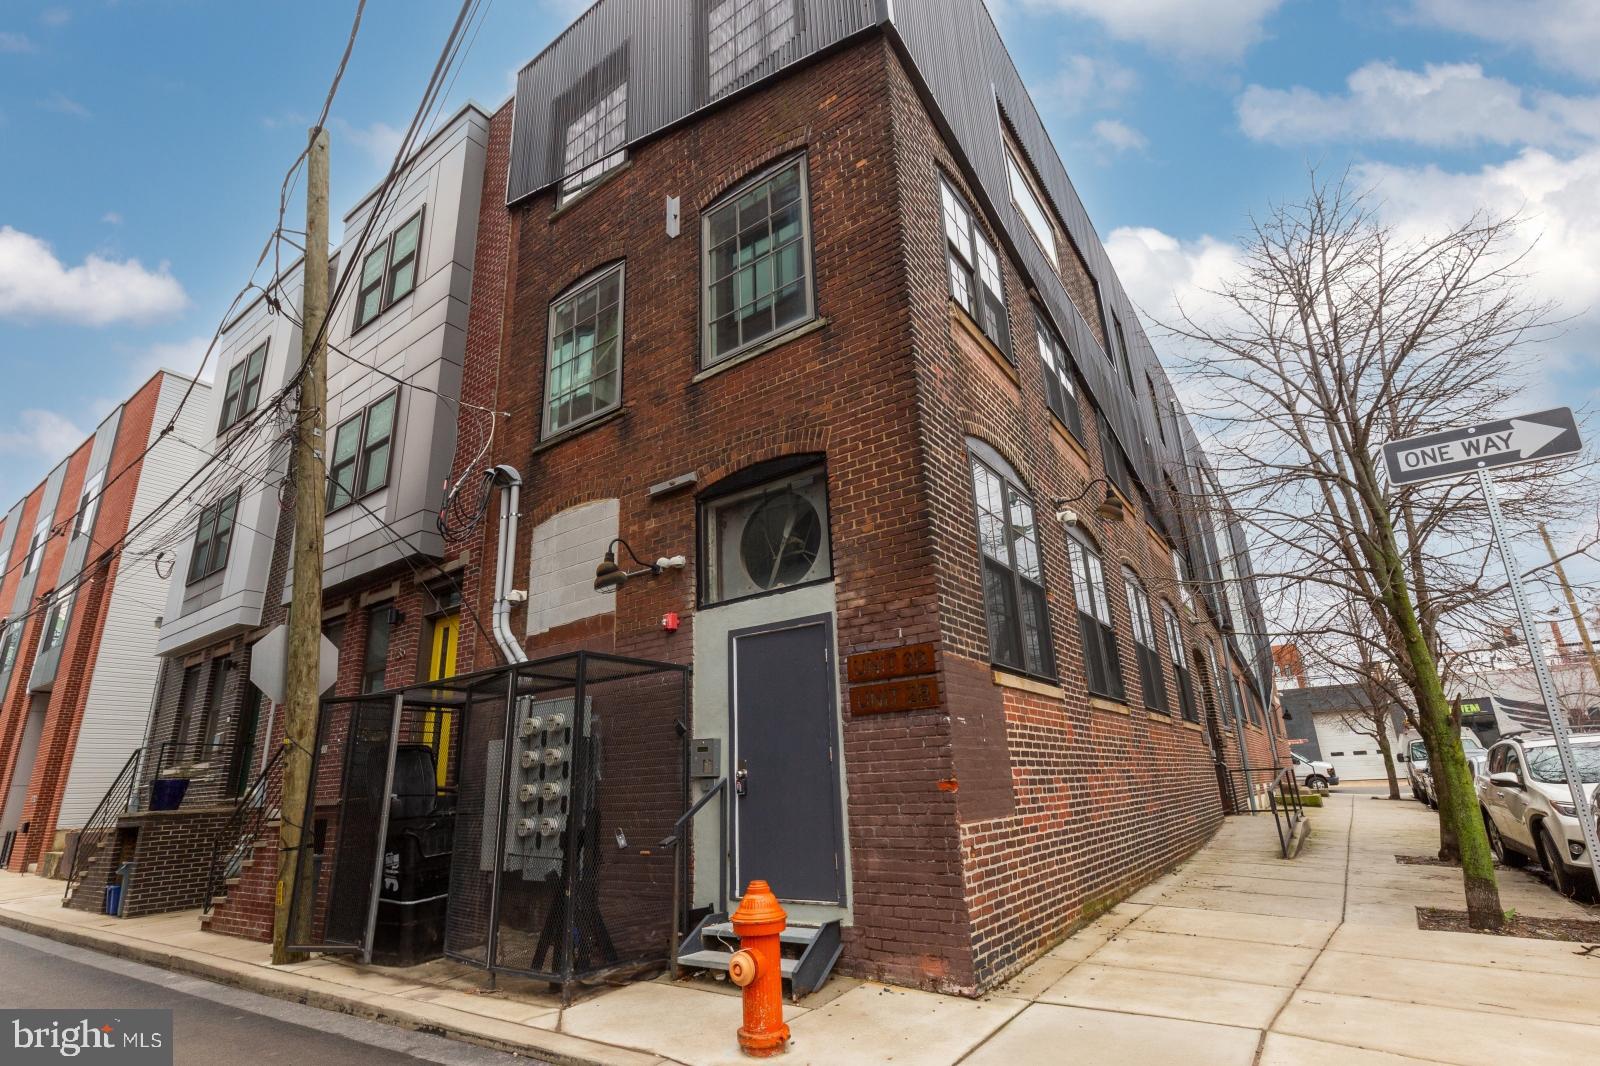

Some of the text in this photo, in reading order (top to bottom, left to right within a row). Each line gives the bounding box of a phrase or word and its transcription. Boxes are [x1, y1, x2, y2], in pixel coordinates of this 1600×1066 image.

[1404, 431, 1513, 467] ONE WAY
[853, 652, 896, 676] UNIT
[857, 686, 897, 709] UNIT
